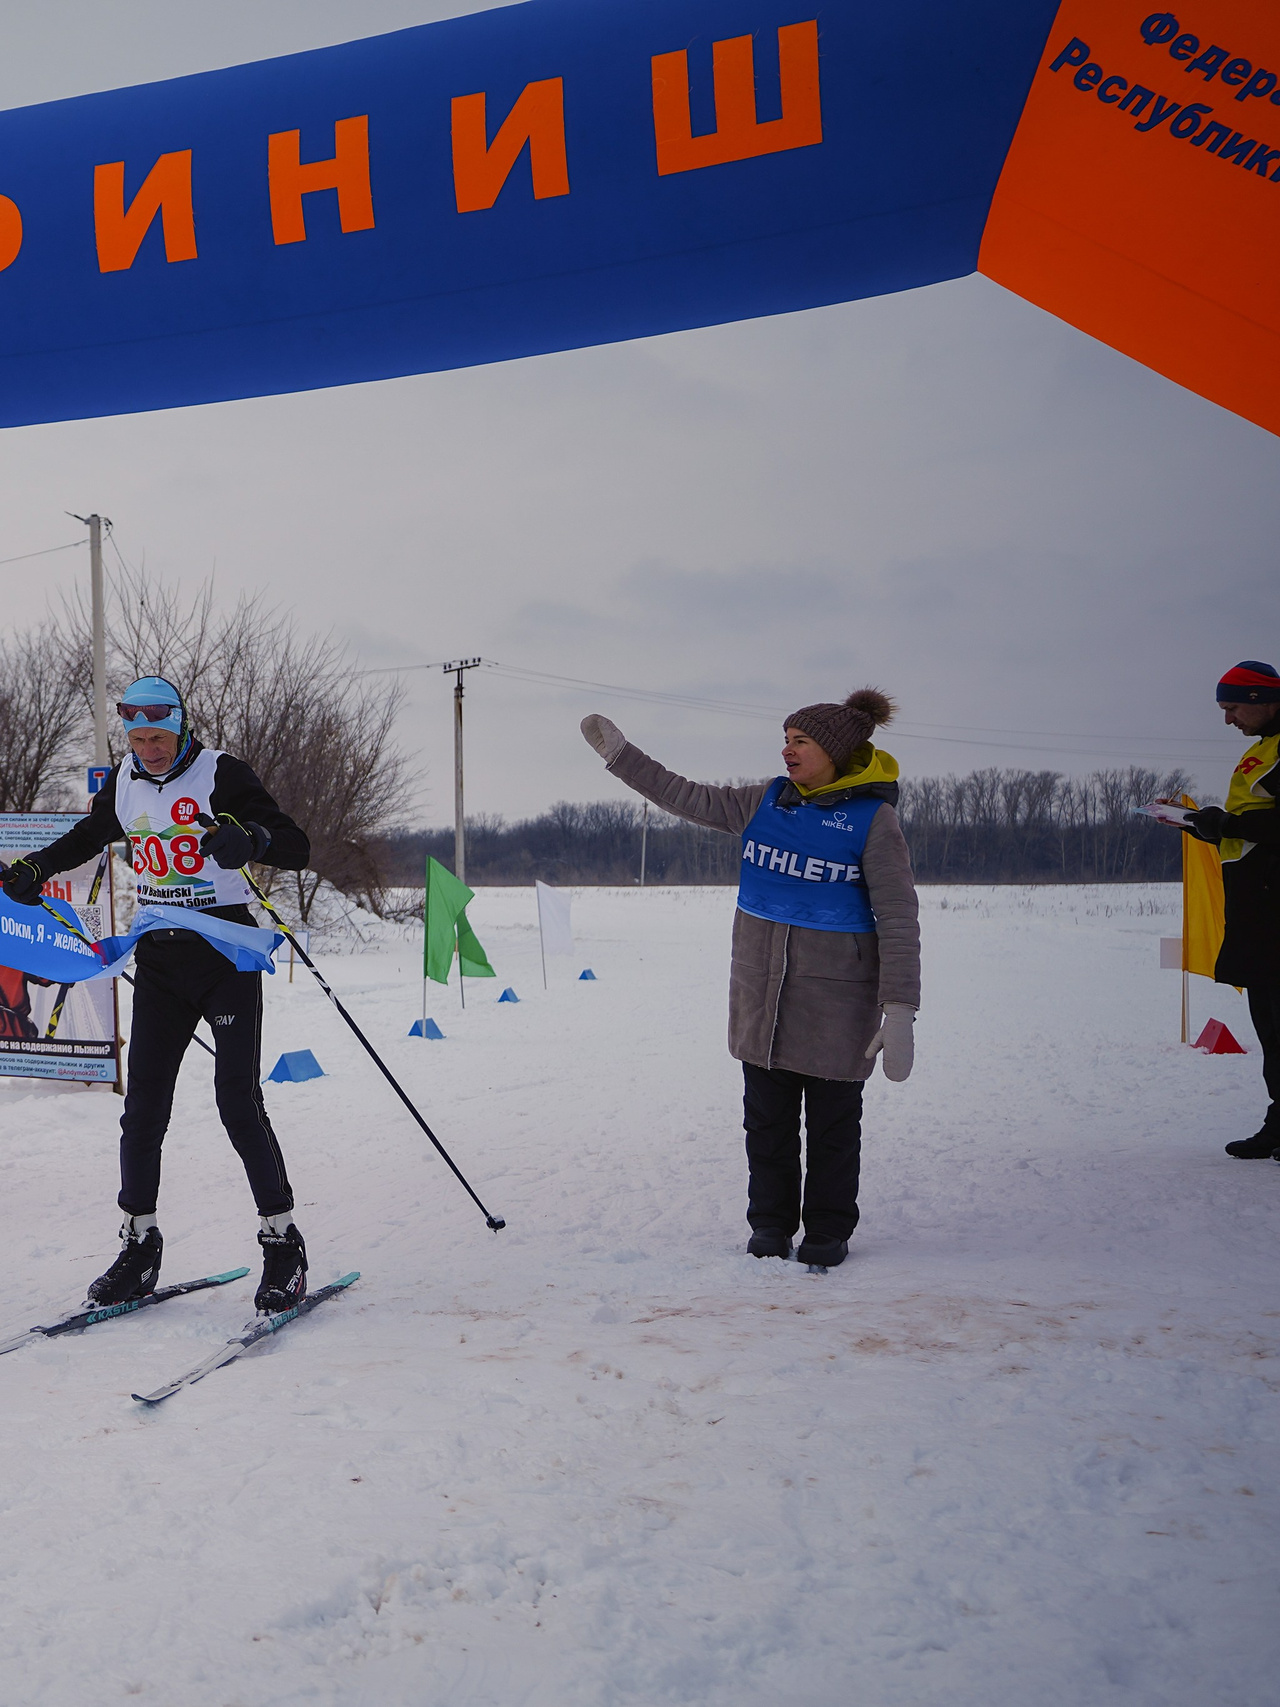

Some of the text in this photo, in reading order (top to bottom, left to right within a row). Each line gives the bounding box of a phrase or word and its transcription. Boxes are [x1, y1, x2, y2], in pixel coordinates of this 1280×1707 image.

[178, 802, 194, 815] 50
[821, 819, 854, 832] NIKELS
[36, 924, 45, 943] Я
[53, 932, 96, 958] железны
[214, 1015, 235, 1026] RAY
[10, 1041, 20, 1050] на
[21, 1042, 73, 1053] содержание
[74, 1044, 110, 1055] лыжни?
[286, 1265, 302, 1293] SPINE
